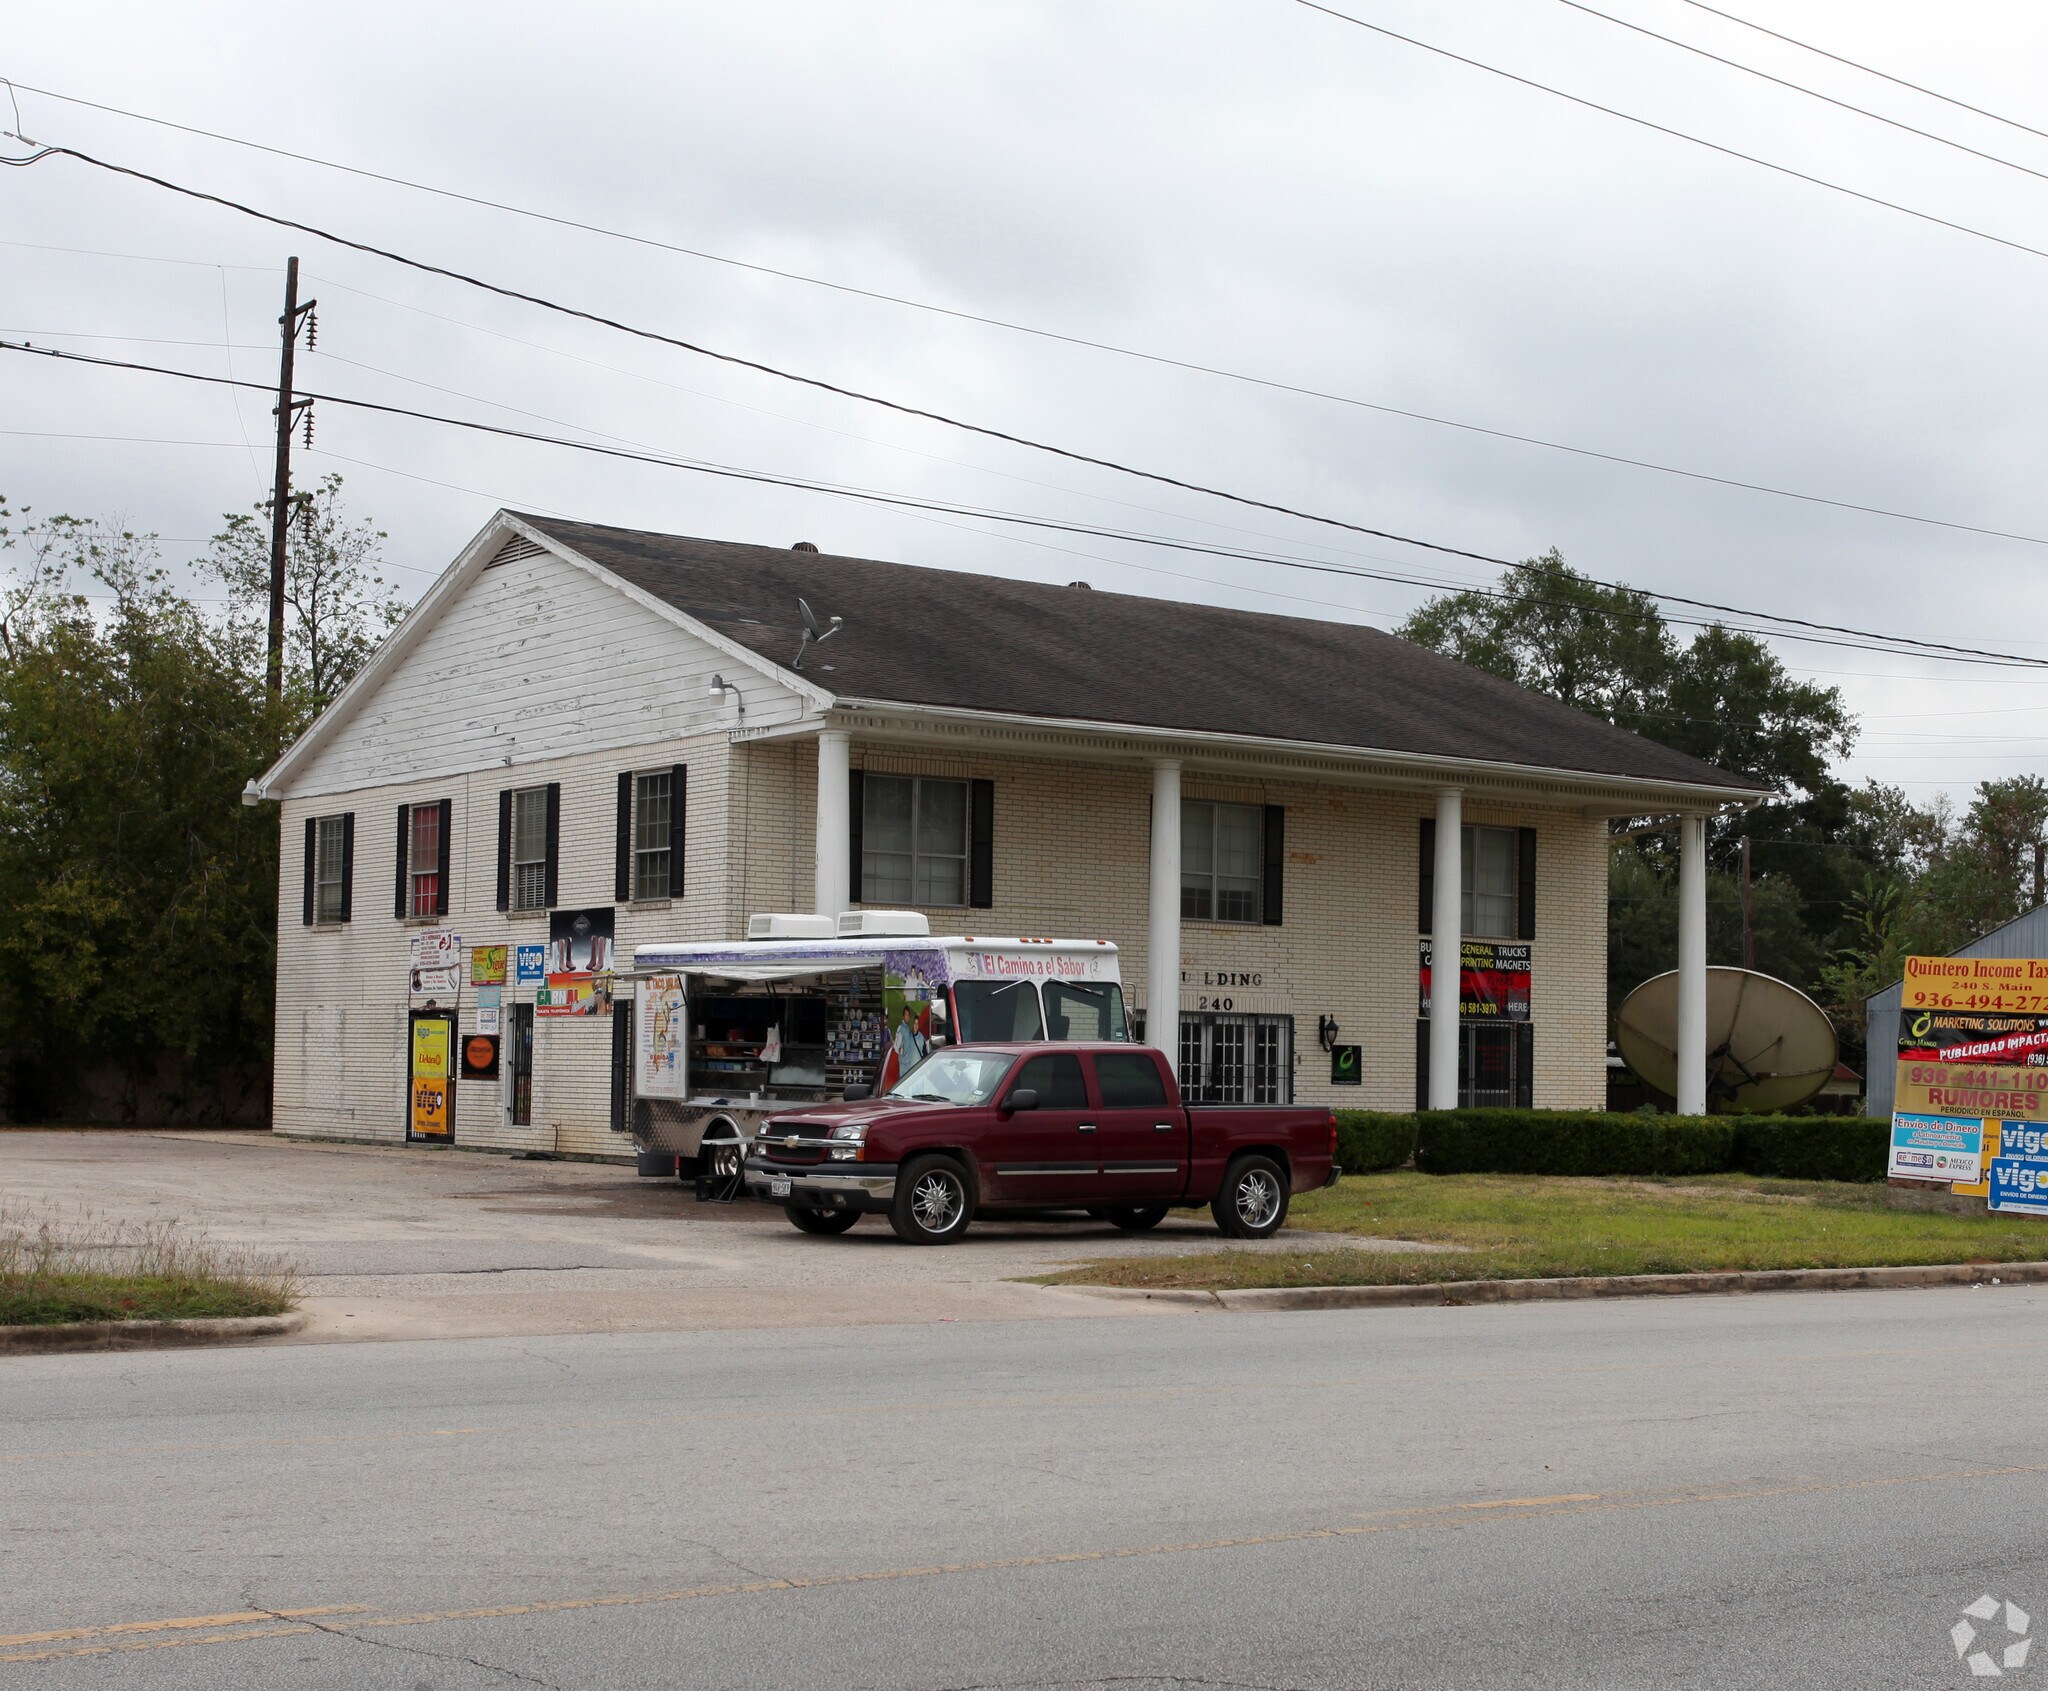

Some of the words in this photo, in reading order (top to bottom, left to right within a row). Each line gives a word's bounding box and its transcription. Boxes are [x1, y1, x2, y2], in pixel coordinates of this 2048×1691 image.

[1461, 944, 1494, 956] GENERAL
[1498, 946, 1527, 957] TRUCKS
[487, 948, 505, 973] Sigue
[519, 947, 543, 970] vigo
[984, 955, 996, 974] El
[998, 955, 1034, 975] Camino
[1037, 961, 1044, 975] a
[1057, 956, 1085, 976] Sabor
[1460, 957, 1494, 968] PRINTING
[1495, 959, 1531, 971] MAGNETS
[1907, 957, 1969, 977] Quintero
[1974, 960, 2022, 977] Income
[2028, 961, 2048, 978] Tax
[1952, 981, 1977, 990] 240
[1982, 982, 1993, 990] S.
[1999, 983, 2032, 991] Main
[1199, 996, 1233, 1010] 240
[1508, 1002, 1528, 1012] HERE
[1933, 1017, 1985, 1031] MARKETING
[1987, 1018, 2035, 1031] SOLUTIONS
[1940, 1040, 2005, 1060] PUBLICIDAD
[2027, 1053, 2045, 1066] (936)
[416, 1083, 443, 1116] vigo
[1928, 1087, 2040, 1110] RUMORES
[1941, 1106, 1980, 1115] PERIODICO
[1992, 1108, 2025, 1118] ESPAÑOL
[1931, 1122, 1942, 1130] de
[1946, 1122, 1978, 1133] Dinero
[1950, 1158, 1974, 1166] MEXICO
[1996, 1162, 2048, 1193] vigo
